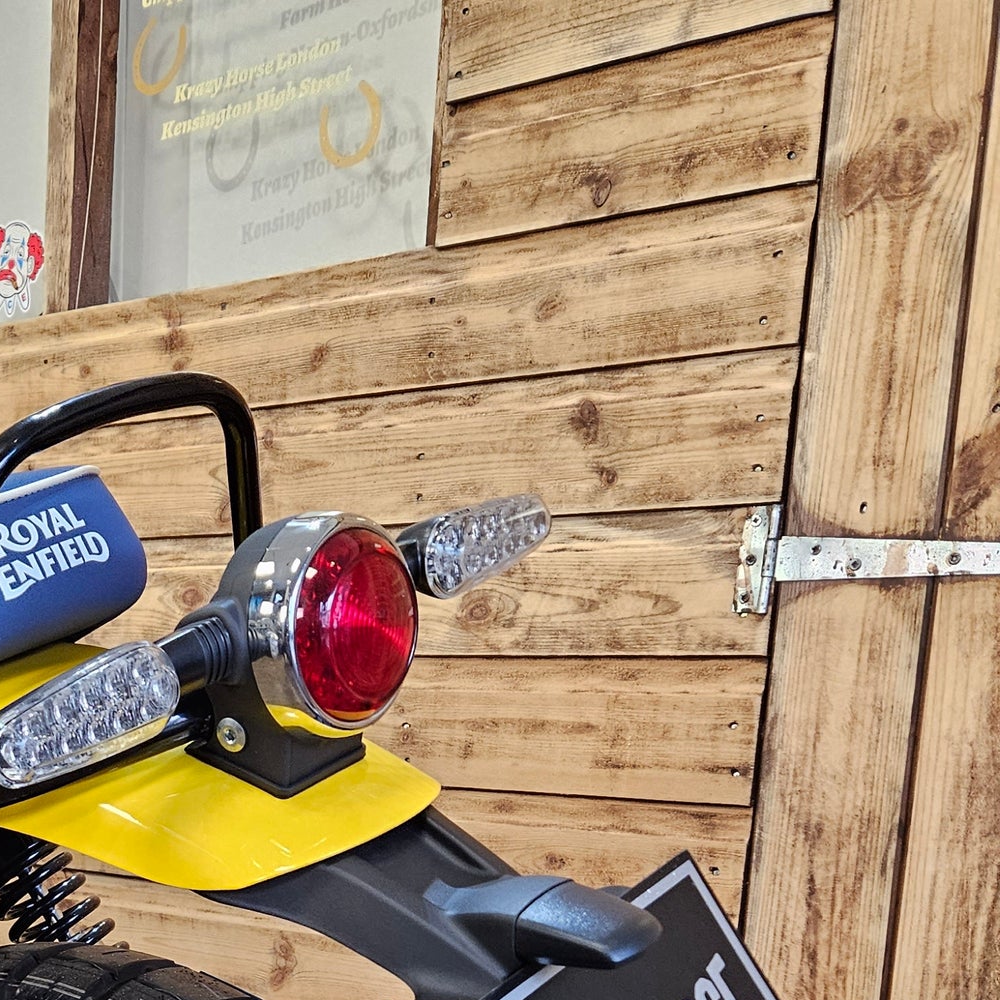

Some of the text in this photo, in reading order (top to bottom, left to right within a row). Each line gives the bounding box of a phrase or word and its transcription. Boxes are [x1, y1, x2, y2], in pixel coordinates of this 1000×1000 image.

[160, 65, 353, 140] Kensington High Street
[174, 38, 342, 104] Krazy Horse London
[241, 196, 332, 244] Kensington
